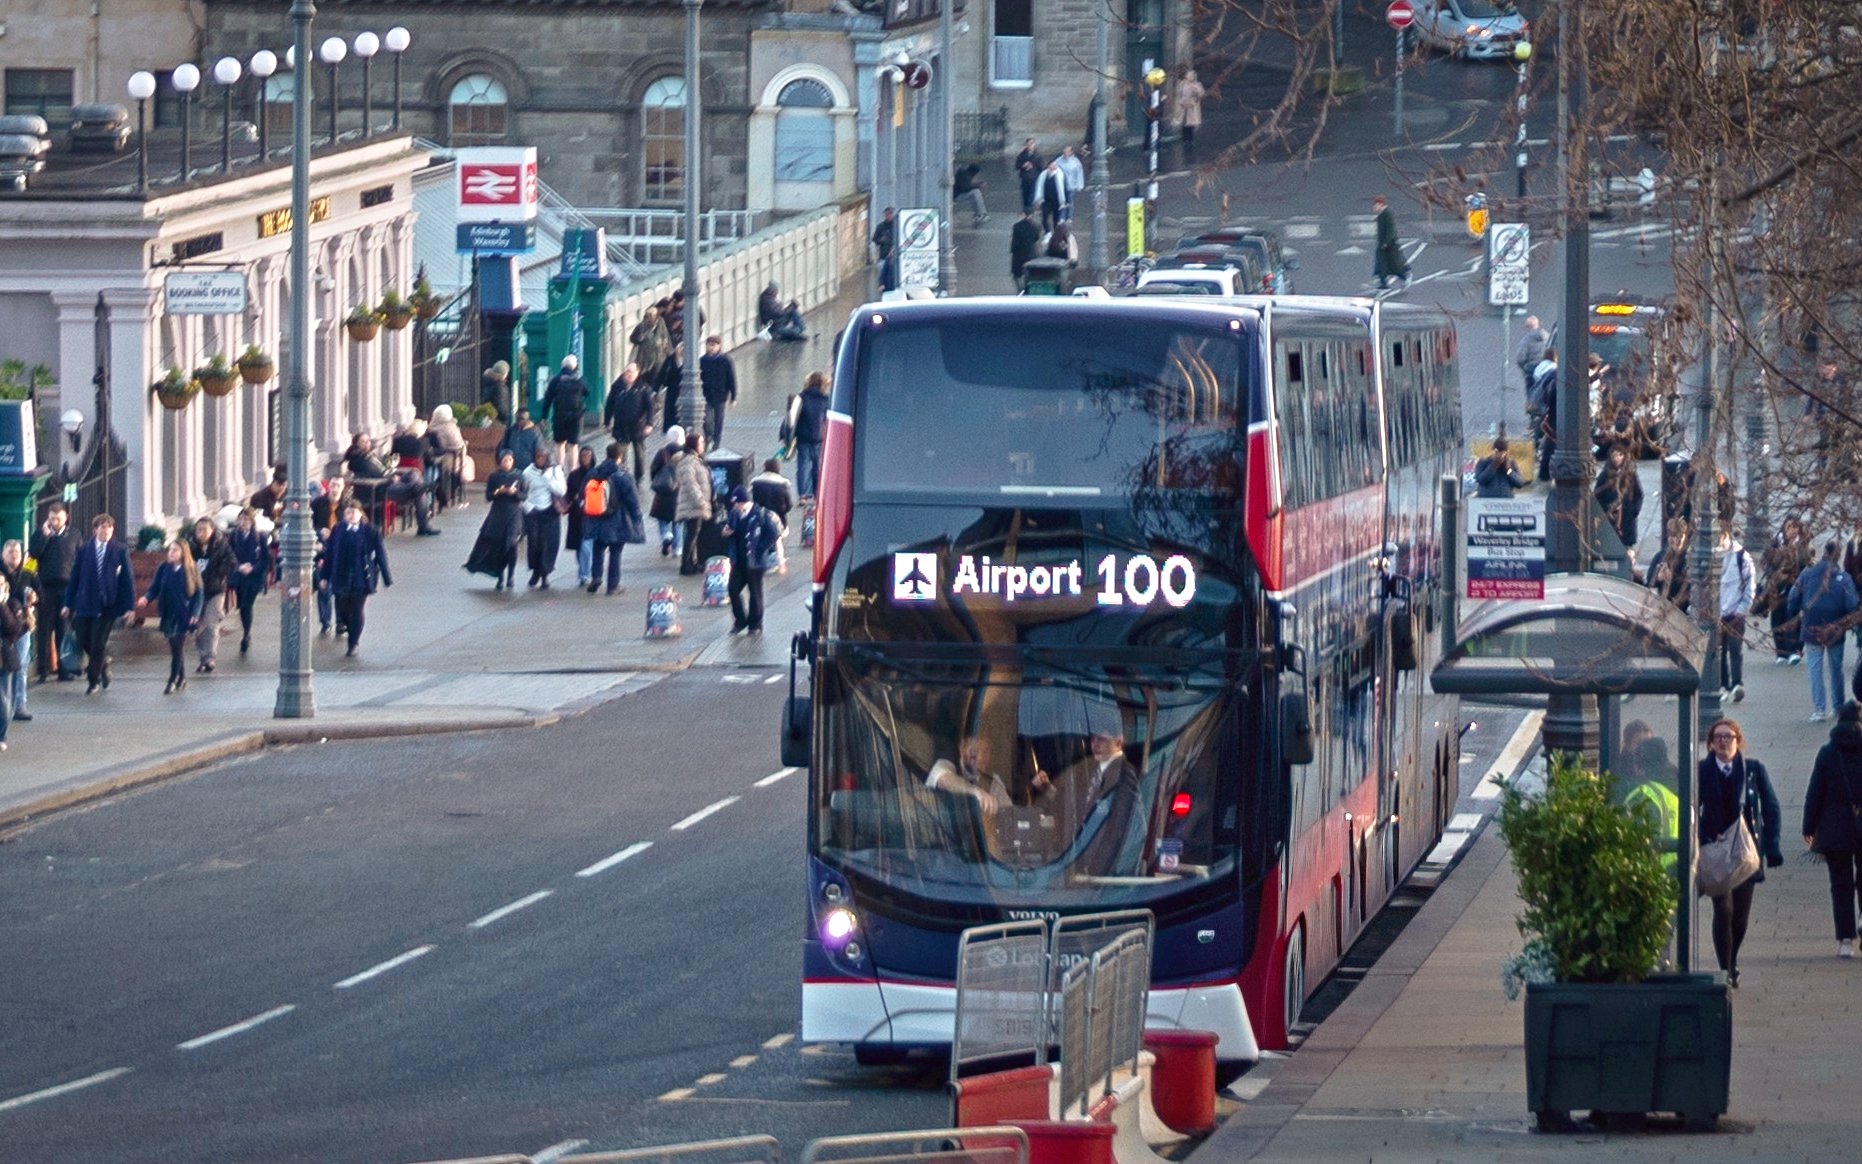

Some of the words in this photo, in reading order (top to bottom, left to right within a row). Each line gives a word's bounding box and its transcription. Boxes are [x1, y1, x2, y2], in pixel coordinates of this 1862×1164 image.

[169, 287, 208, 298] BOOKING
[211, 287, 241, 297] OFFICE
[1473, 535, 1511, 546] Waverley
[1512, 535, 1540, 546] Bridge
[1487, 546, 1503, 556] Bus
[1505, 546, 1525, 558] Stop
[953, 555, 1082, 601] Airport
[1097, 553, 1196, 607] 100
[650, 602, 674, 619] 900
[1008, 910, 1060, 921] VOLVO
